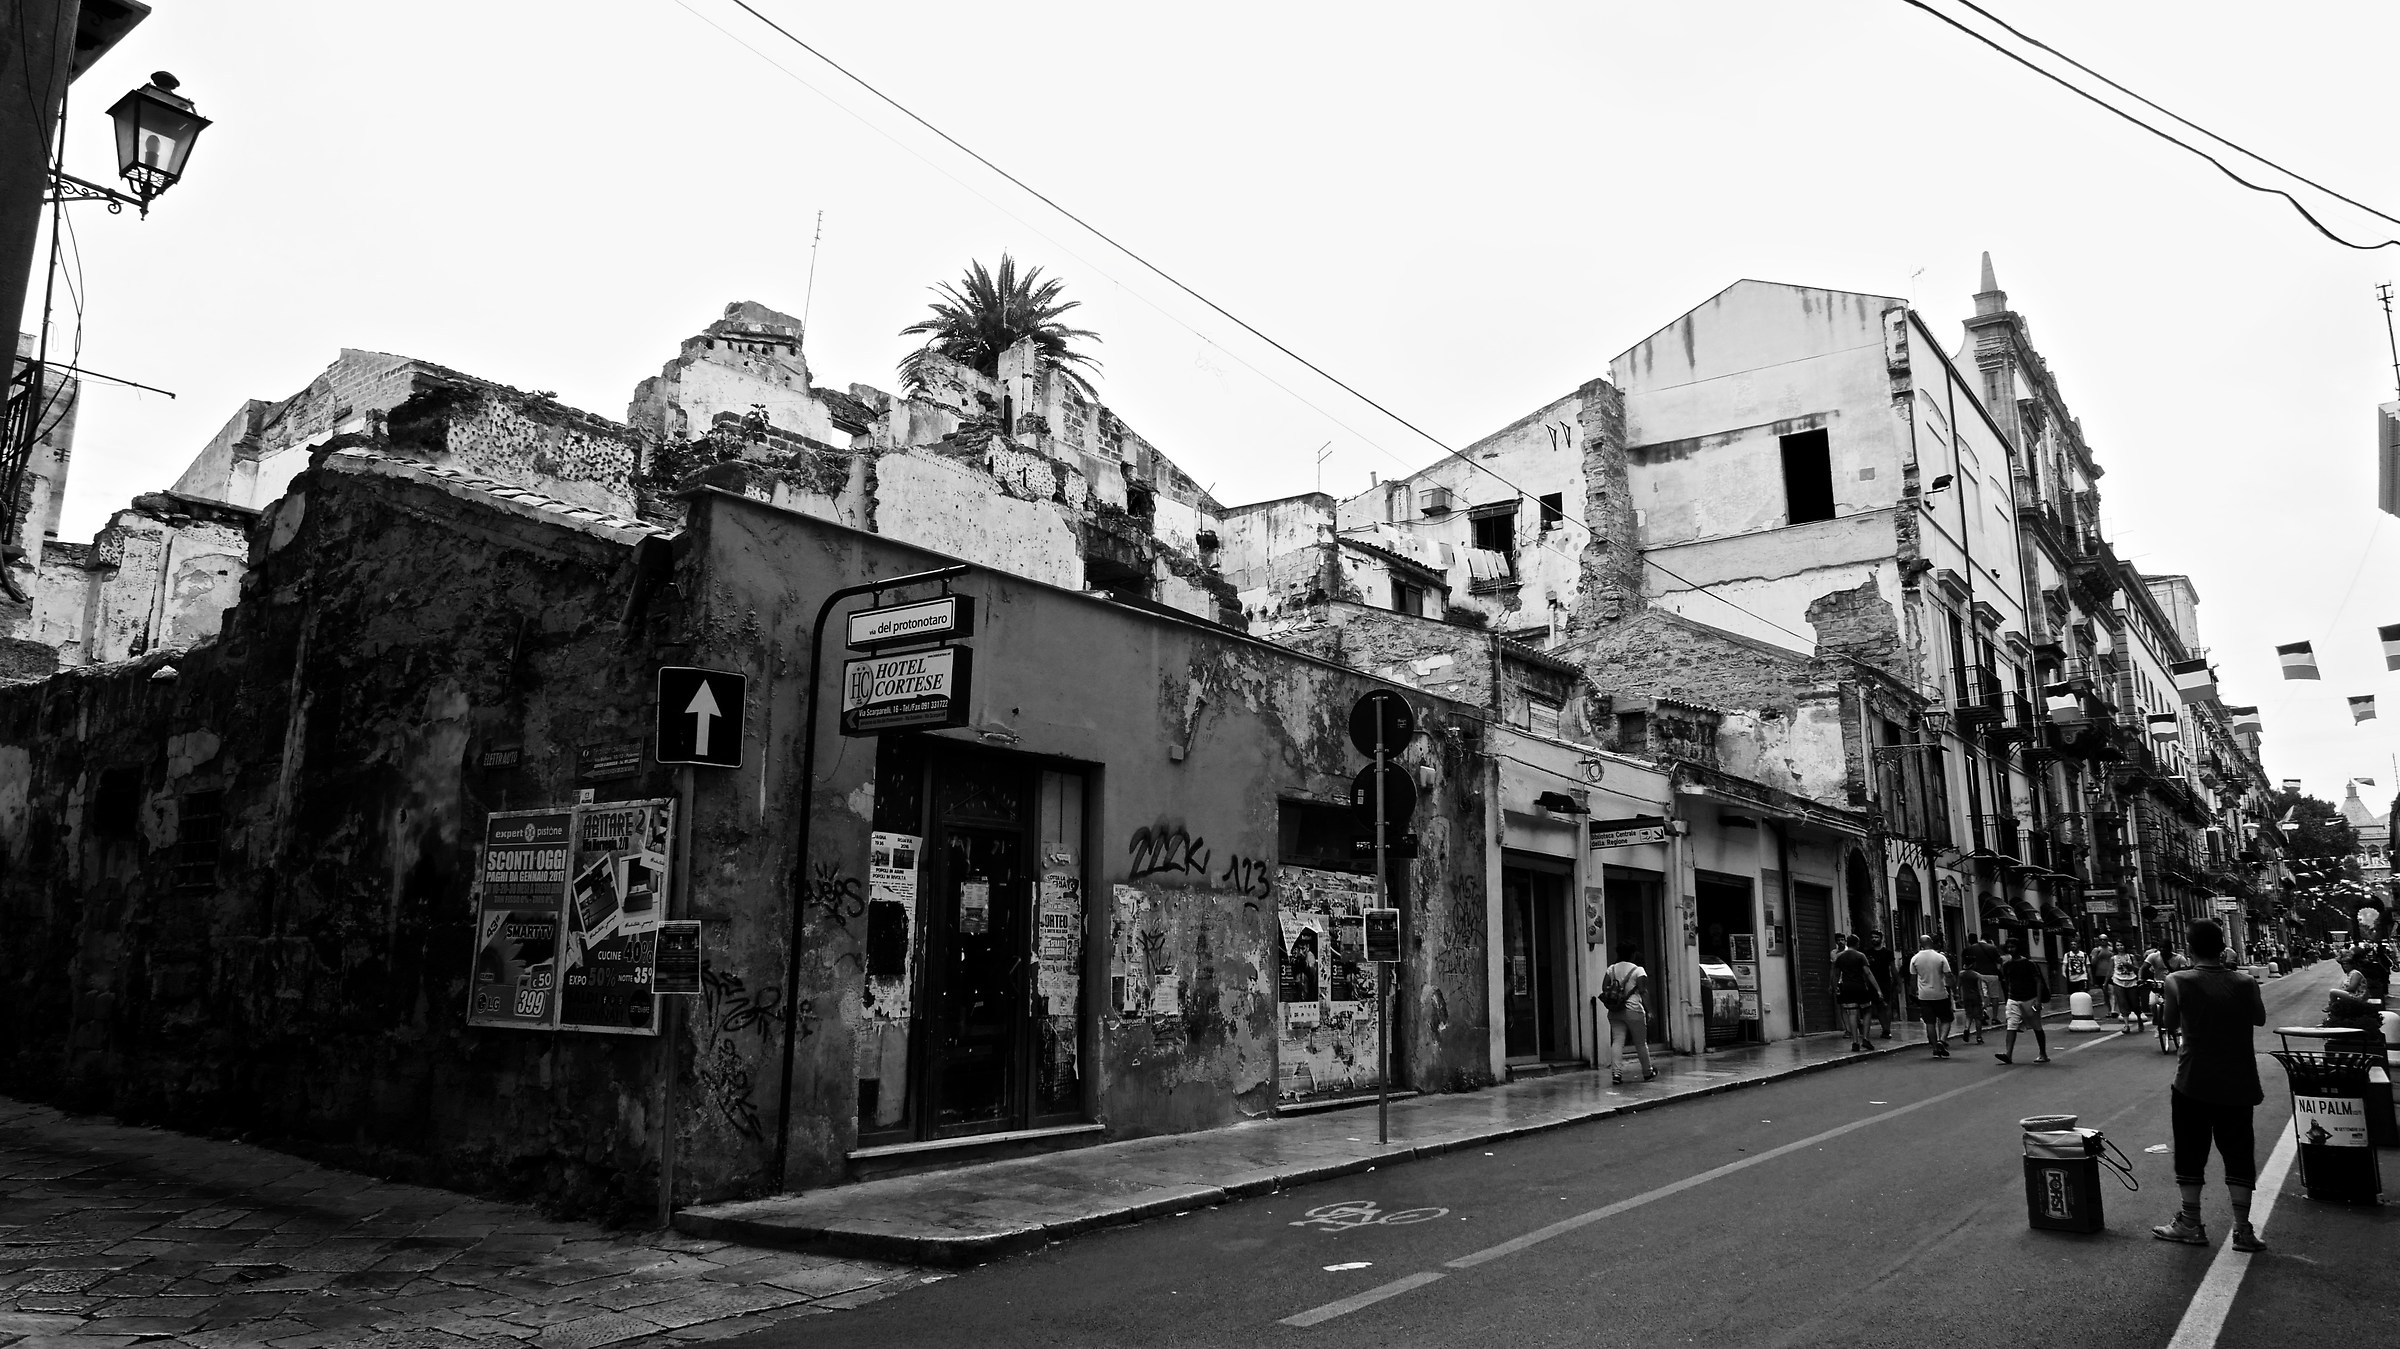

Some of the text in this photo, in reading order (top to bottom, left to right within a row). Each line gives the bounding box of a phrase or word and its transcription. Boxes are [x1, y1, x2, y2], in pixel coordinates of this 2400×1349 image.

[877, 621, 892, 634] del
[893, 615, 948, 634] protonotaro
[876, 658, 926, 679] HOTEL
[850, 670, 870, 699] HC
[874, 673, 944, 697] CORTESE
[921, 702, 930, 710] 091
[930, 699, 949, 709] 331722
[495, 826, 563, 839] expert pistone
[583, 809, 646, 838] ABITARE 2
[1615, 830, 1637, 838] Centrale
[487, 849, 567, 871] SCONTI OGGI
[486, 870, 565, 882] PAGHI DA GENNAIO 2017
[506, 924, 553, 939] SMART TV
[597, 941, 653, 963] CUCINE 40%
[568, 975, 587, 986] EXPO
[588, 967, 616, 988] 50%
[488, 996, 500, 1011] LG
[517, 989, 546, 1015] 399
[567, 991, 598, 1003] SALDI
[2298, 1099, 2316, 1114] NAI
[2319, 1101, 2353, 1116] PALM
[2048, 1172, 2065, 1216] FORST
